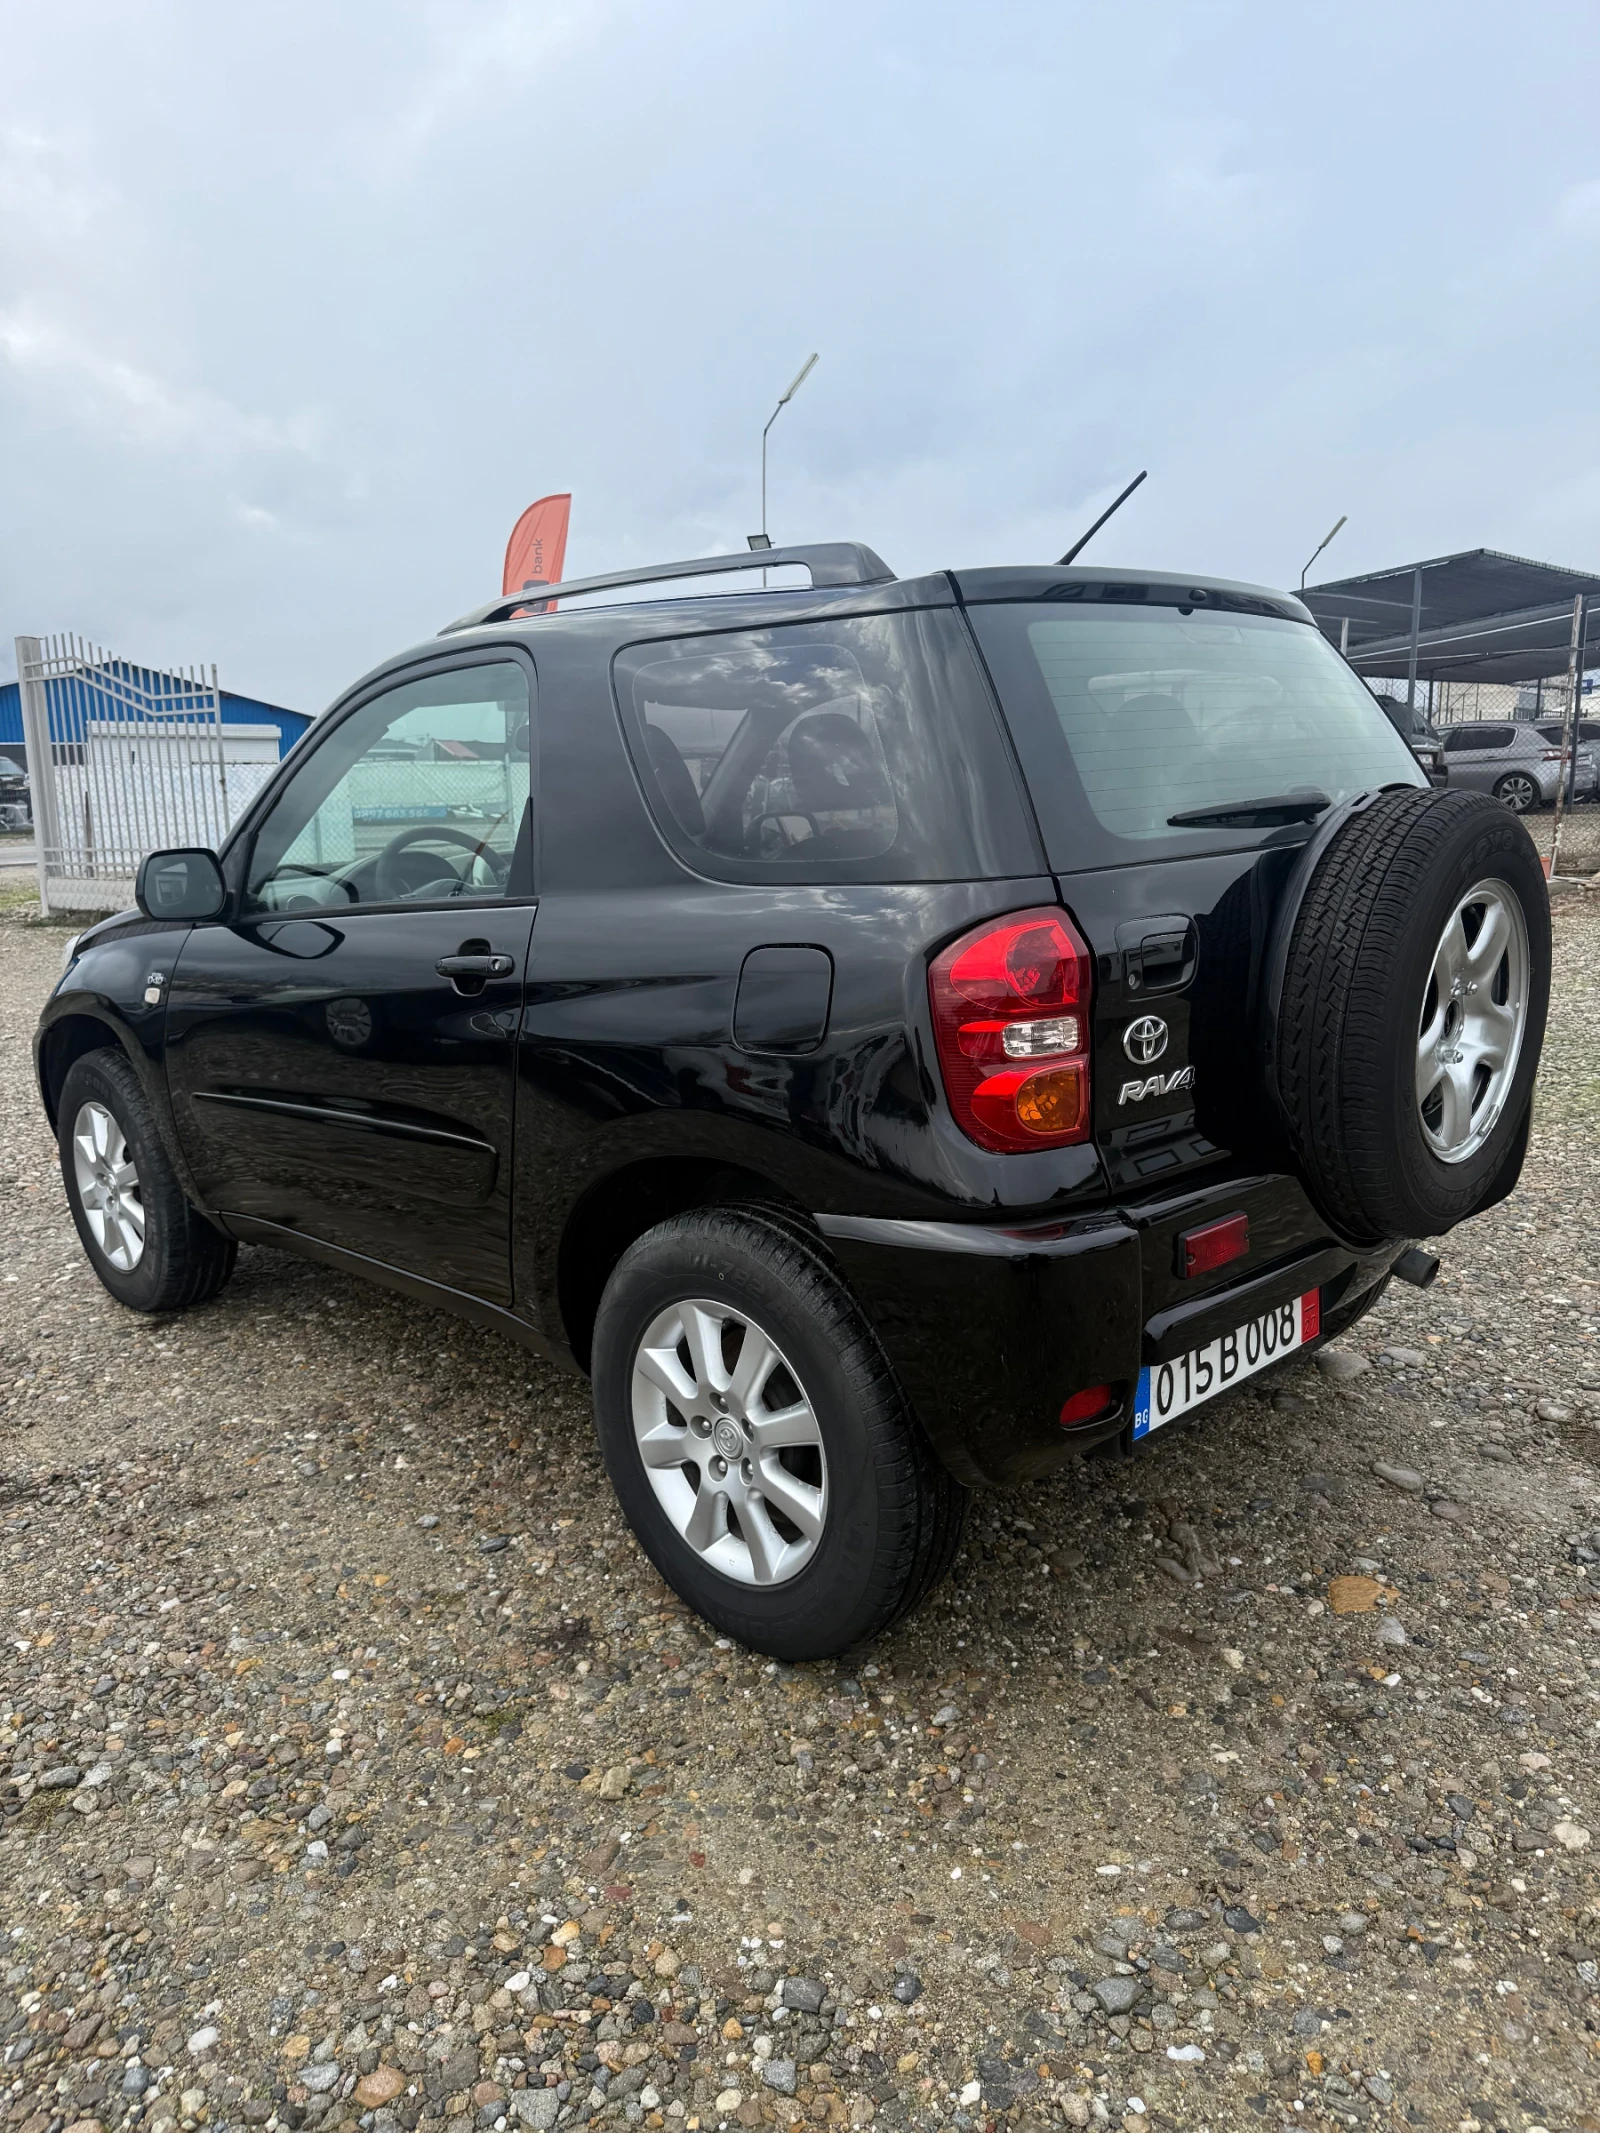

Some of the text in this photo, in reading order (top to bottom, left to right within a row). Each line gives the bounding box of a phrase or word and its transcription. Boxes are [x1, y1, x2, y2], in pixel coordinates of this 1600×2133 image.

[532, 538, 543, 574] bank
[409, 808, 430, 818] 565
[1460, 829, 1514, 879] TOYO
[1117, 1066, 1195, 1106] RAV4
[1303, 1314, 1317, 1335] 27
[1134, 1409, 1149, 1429] BG
